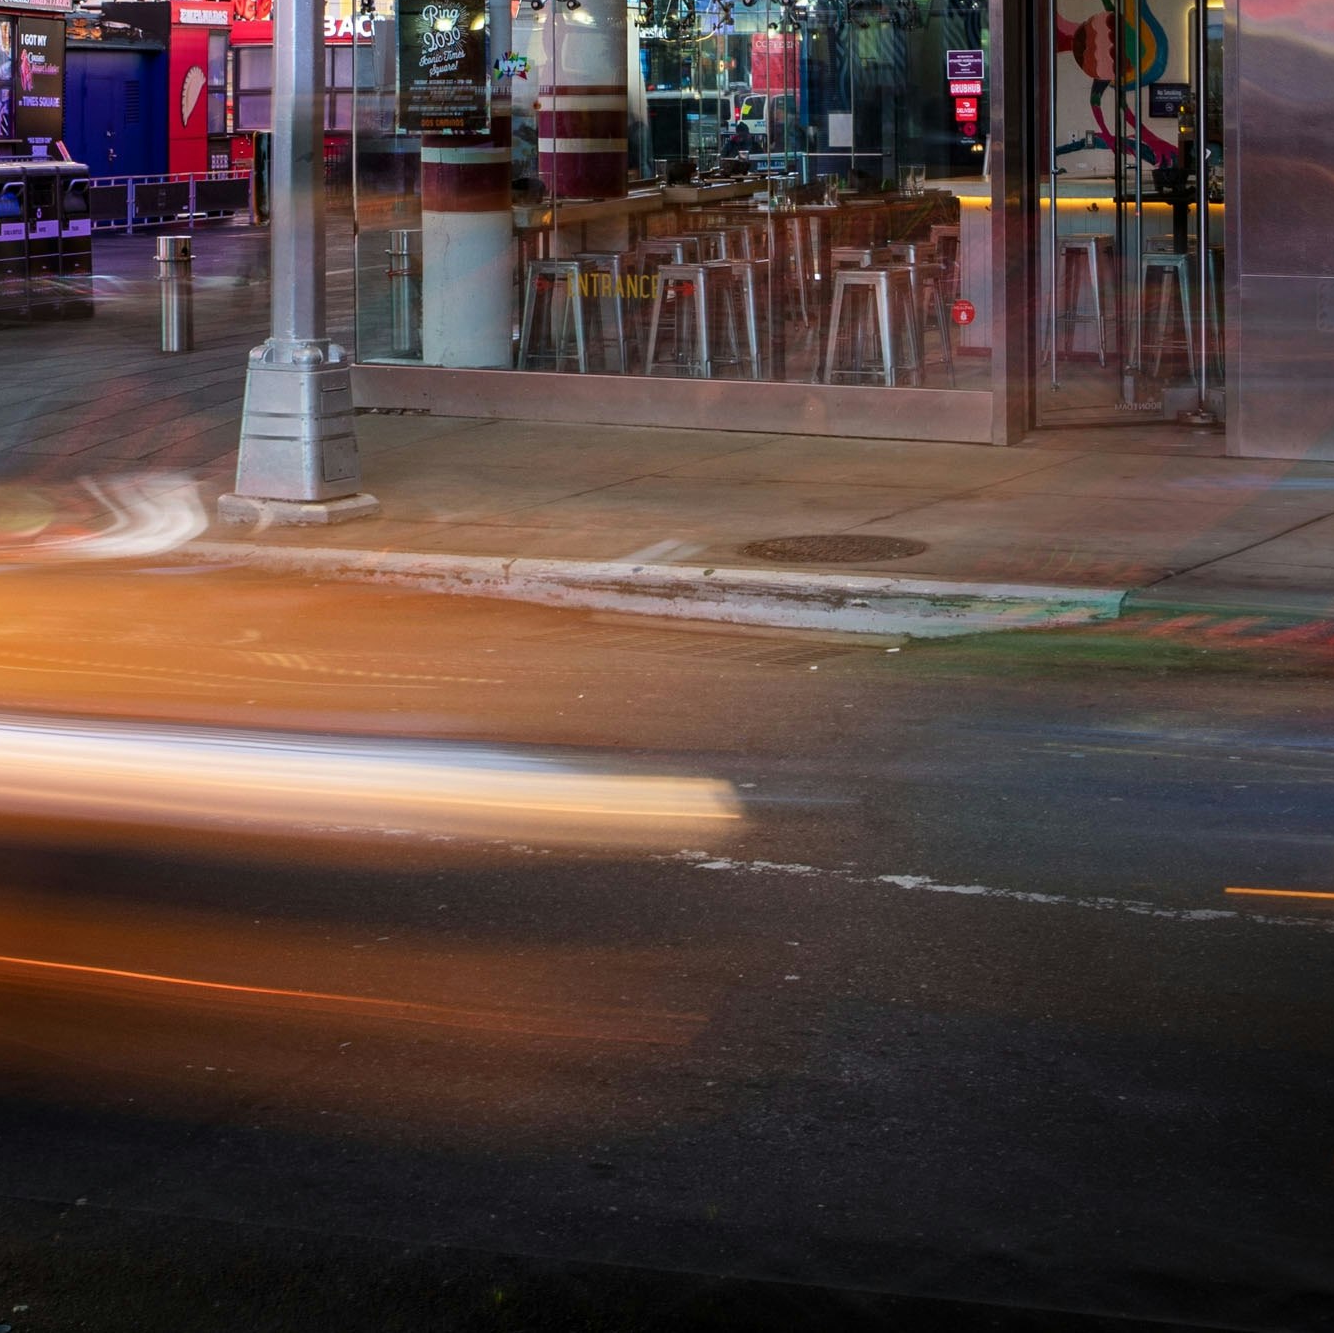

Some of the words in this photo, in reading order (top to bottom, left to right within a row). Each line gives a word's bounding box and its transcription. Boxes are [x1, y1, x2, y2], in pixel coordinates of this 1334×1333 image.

[422, 4, 460, 27] Ring
[25, 34, 37, 46] GOT
[37, 35, 47, 47] MY
[423, 26, 461, 53] 2020
[419, 54, 443, 67] Iconic
[444, 49, 466, 62] Times
[429, 61, 459, 78] Square!
[950, 83, 982, 94] GRUBHUB
[22, 96, 39, 107] TIMES
[39, 97, 60, 107] SQUARE
[567, 272, 660, 299] ENTRANCE
